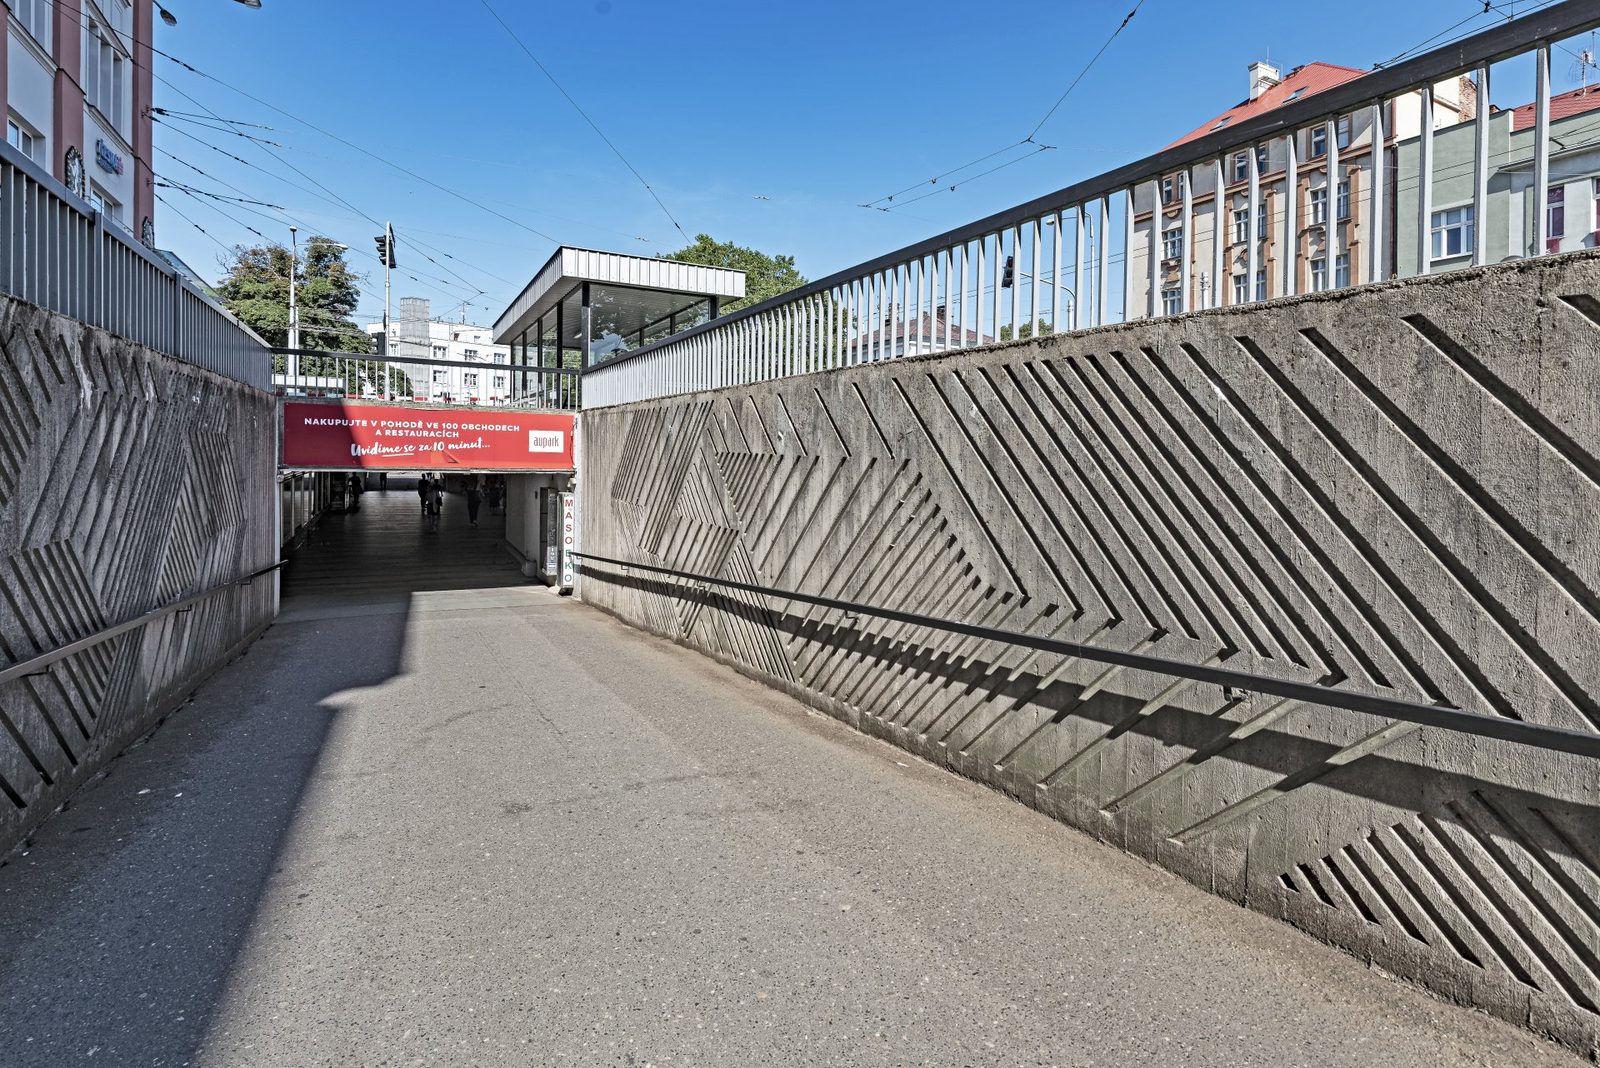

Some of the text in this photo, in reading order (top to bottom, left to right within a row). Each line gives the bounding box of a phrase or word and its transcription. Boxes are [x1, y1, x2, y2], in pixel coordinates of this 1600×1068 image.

[304, 417, 368, 427] NAKUPUJTE
[370, 420, 378, 428] V
[380, 419, 424, 429] POHODĚ
[441, 422, 459, 430] 100
[461, 423, 520, 432] OBCHODECH
[385, 429, 460, 438] RESTAURACÍCH
[403, 443, 416, 453] se
[418, 443, 432, 452] za
[433, 441, 445, 452] 10
[533, 435, 560, 449] aupark
